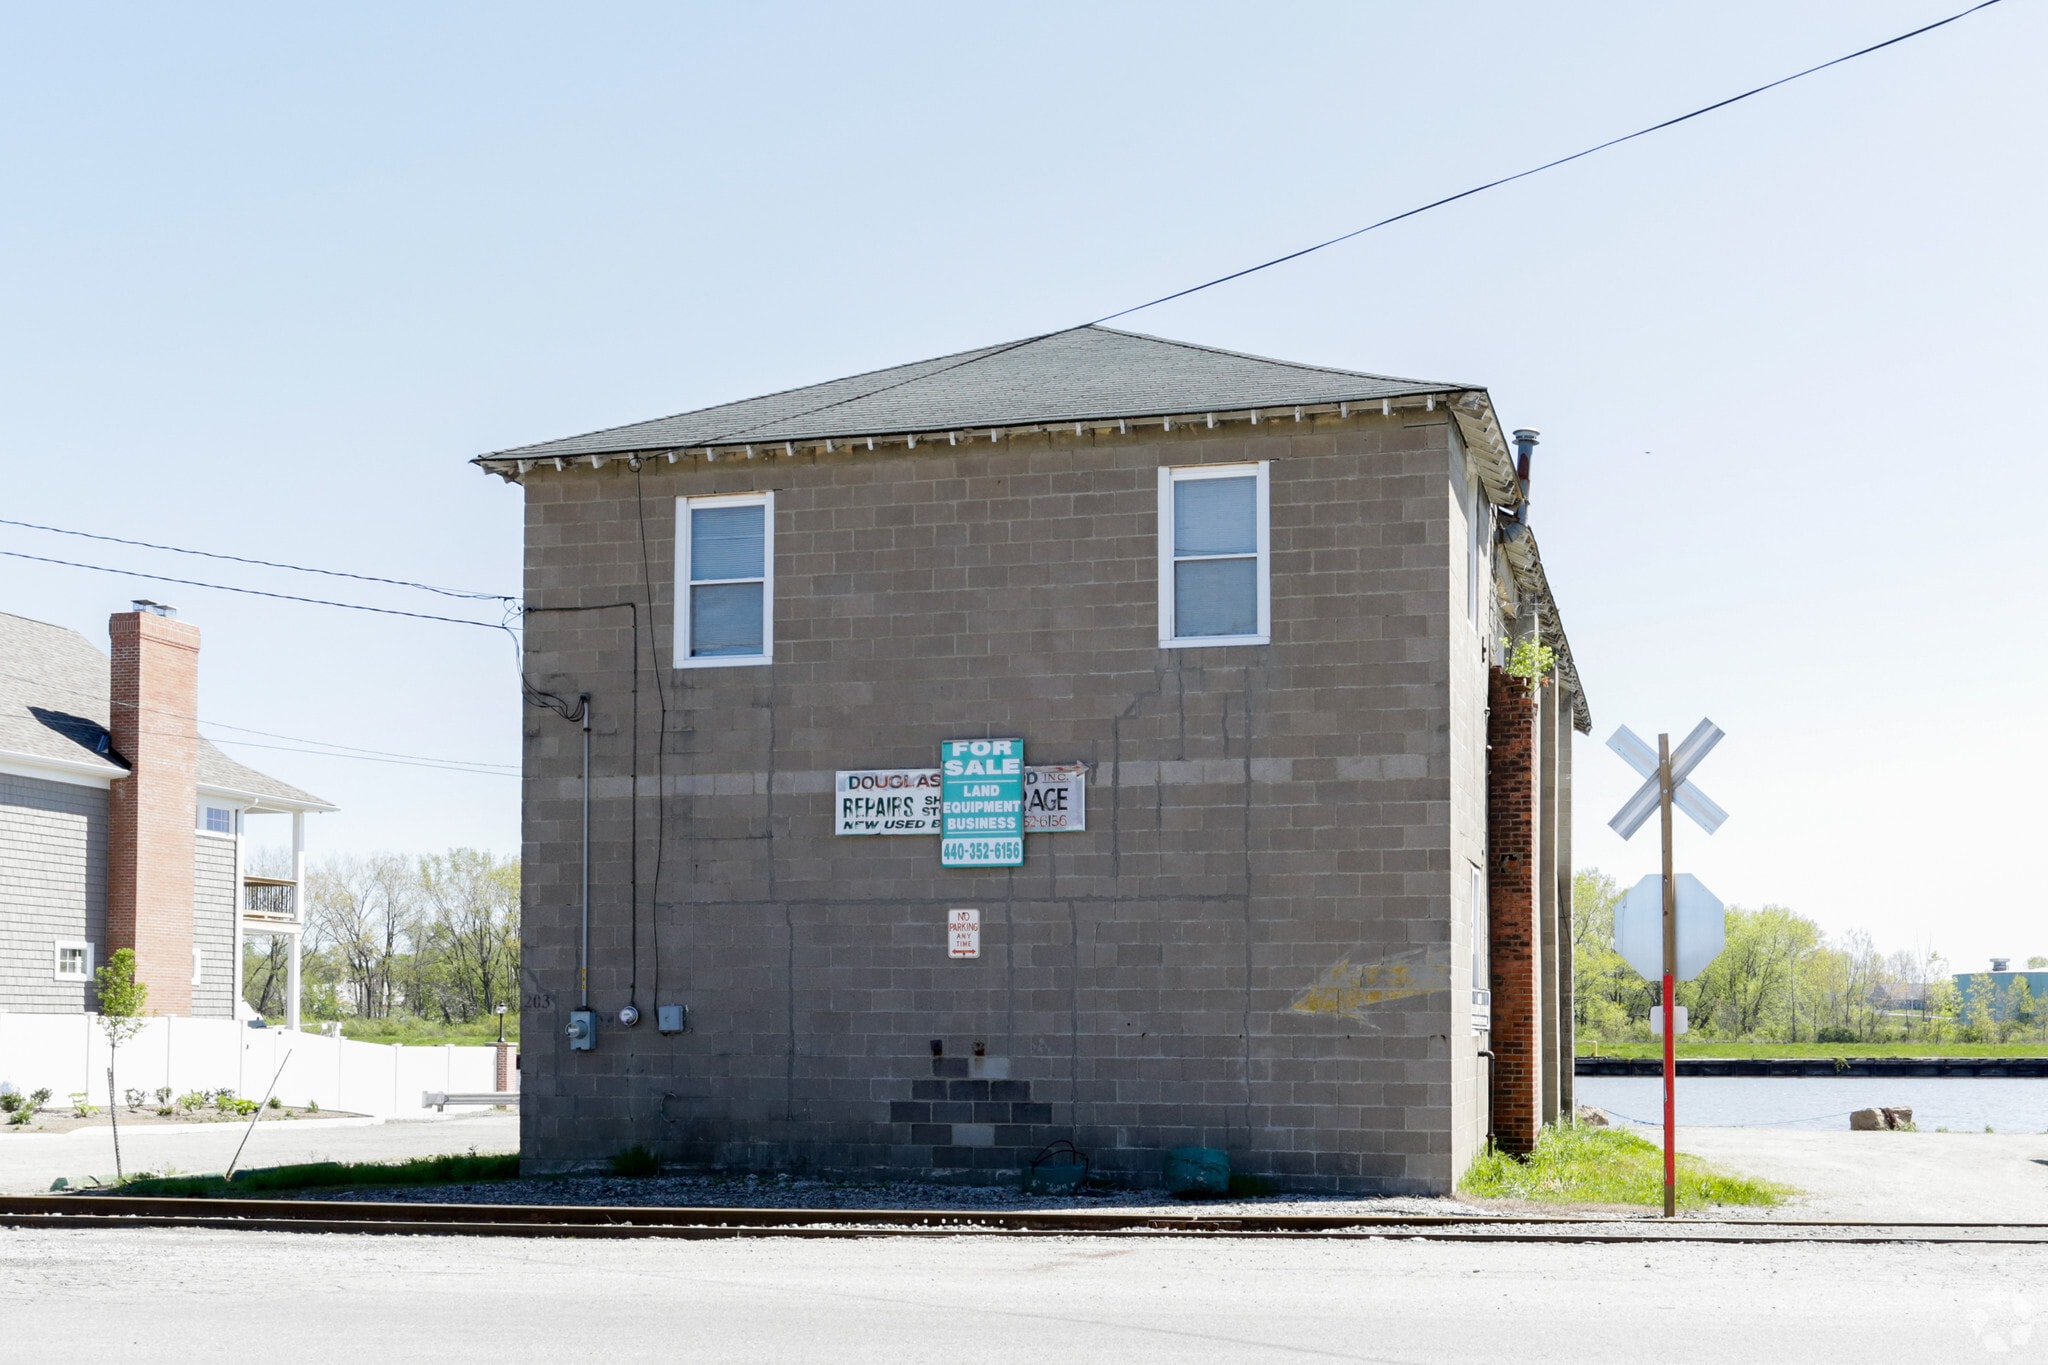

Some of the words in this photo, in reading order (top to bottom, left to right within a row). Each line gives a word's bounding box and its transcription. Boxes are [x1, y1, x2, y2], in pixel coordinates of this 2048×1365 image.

[952, 740, 1012, 756] FOR
[944, 759, 1020, 776] SALE
[848, 773, 941, 790] DOUGLAS
[1043, 773, 1069, 781] INC.
[963, 784, 1000, 797] LAND
[843, 796, 914, 818] REPAIRS
[1023, 788, 1069, 811] AGE
[943, 801, 1021, 814] EQUIPMENT
[922, 807, 941, 817] ST
[884, 819, 926, 829] USED
[947, 817, 1016, 830] BUSINESS
[943, 841, 1020, 860] 440-352-6156
[957, 911, 970, 922] NO
[949, 922, 979, 932] PARKING
[956, 932, 972, 940] ANY
[956, 940, 972, 948] TIME
[523, 993, 550, 1009] 203
